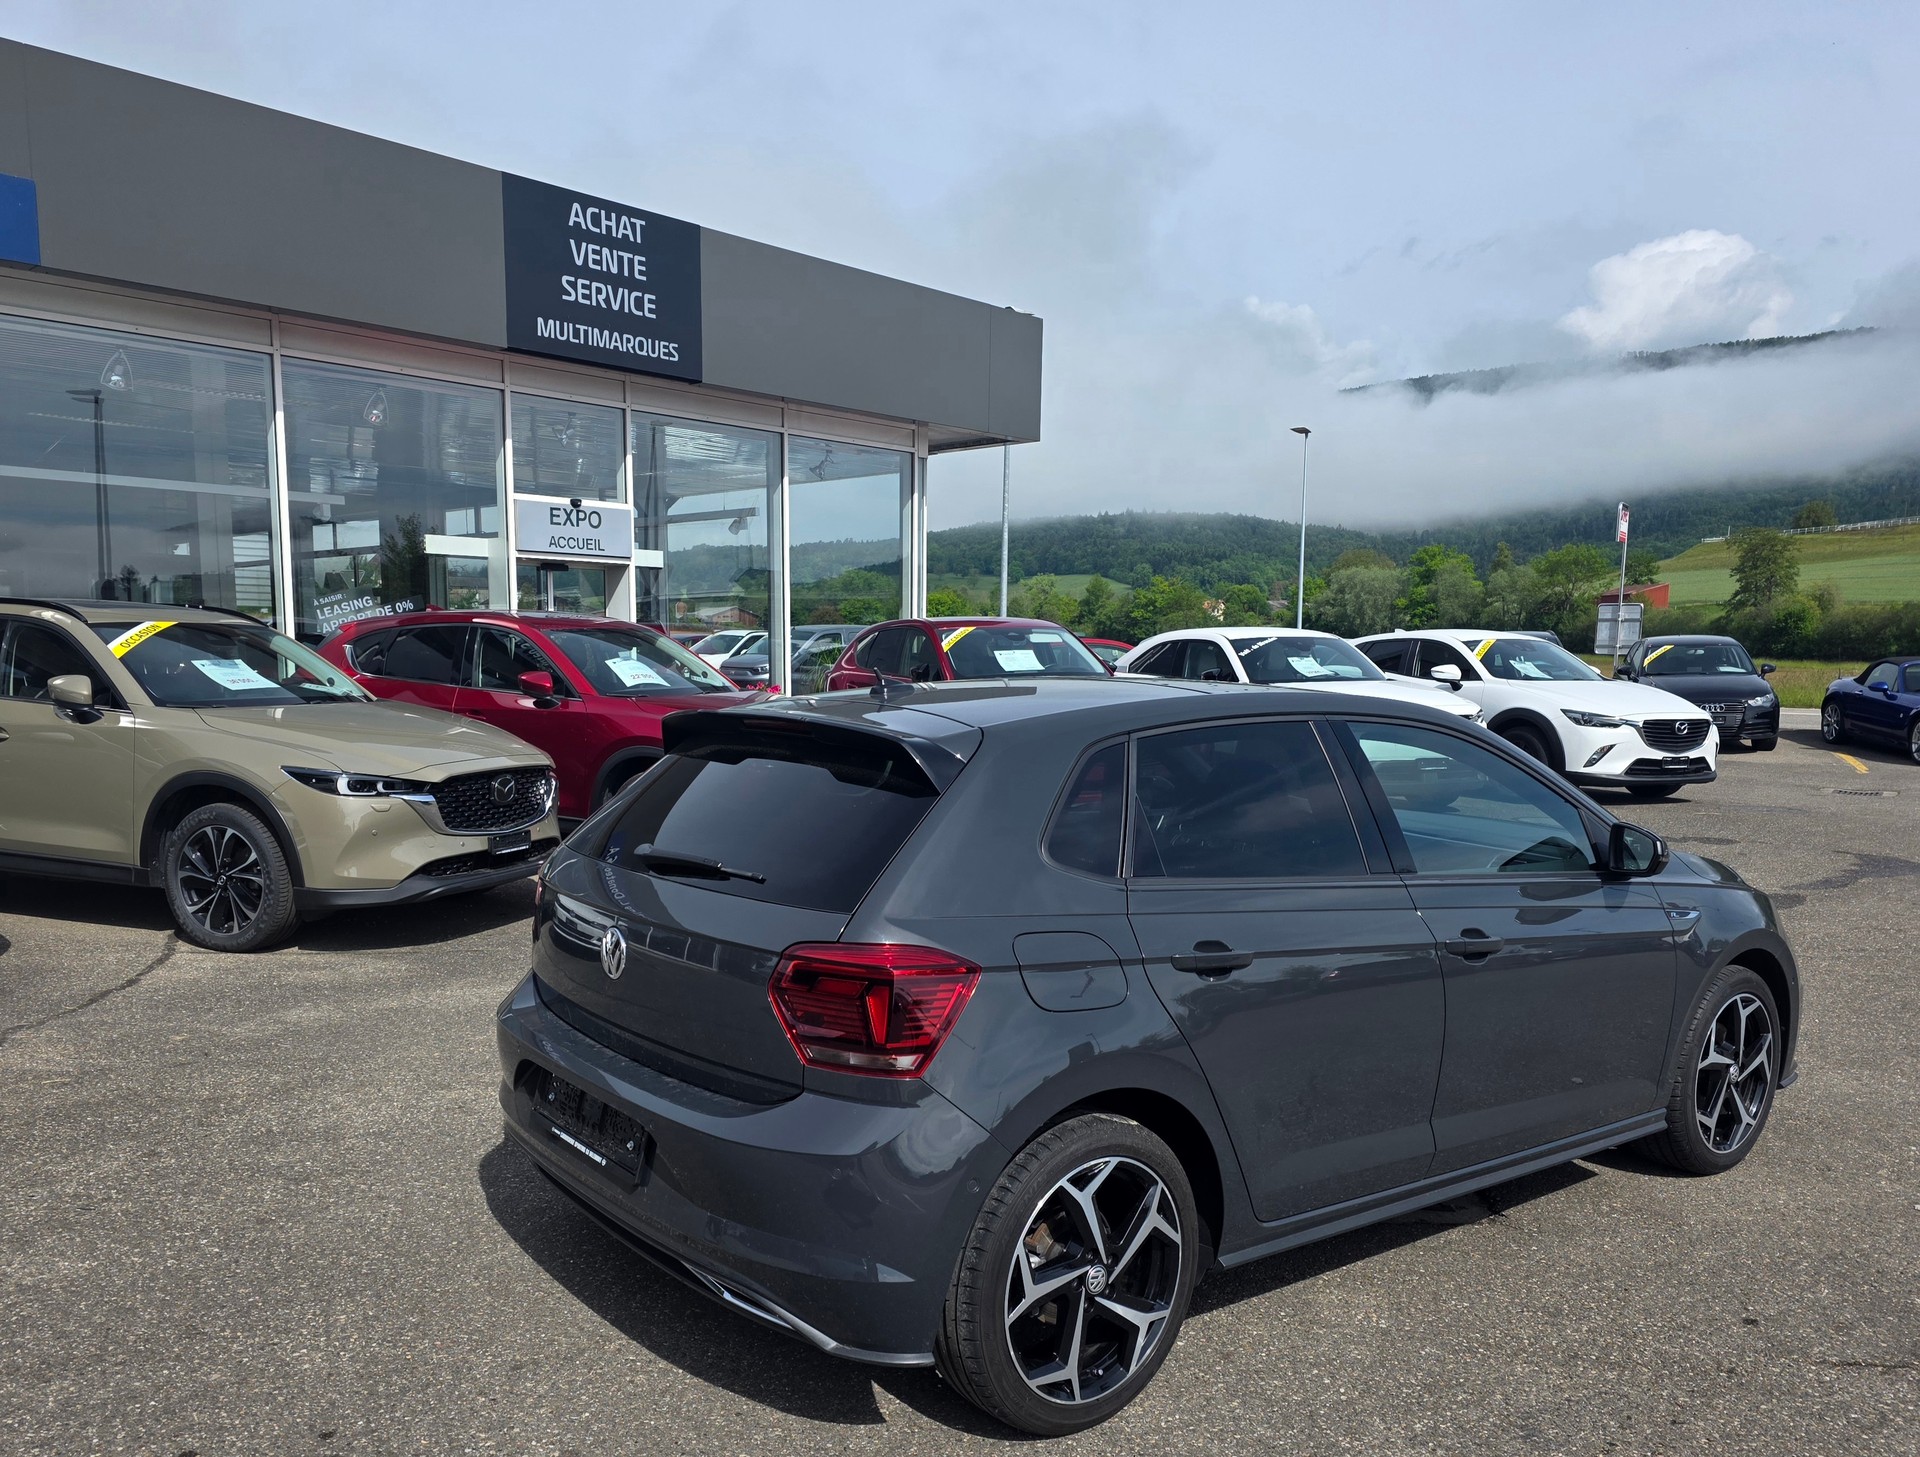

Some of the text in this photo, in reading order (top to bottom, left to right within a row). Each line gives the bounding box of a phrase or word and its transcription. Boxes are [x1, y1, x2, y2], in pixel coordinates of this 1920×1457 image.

[568, 202, 646, 244] ACHAT
[569, 238, 647, 281] VENTE
[561, 275, 657, 319] SERVICE
[537, 316, 679, 361] MULTIMARQUES
[549, 506, 602, 529] EXPO
[548, 535, 605, 552] ACCUEIL
[316, 596, 373, 620] LEASING
[320, 594, 343, 605] SAISIR
[375, 605, 394, 617] DE
[395, 600, 414, 613] 0%
[119, 623, 162, 649] OCCASION
